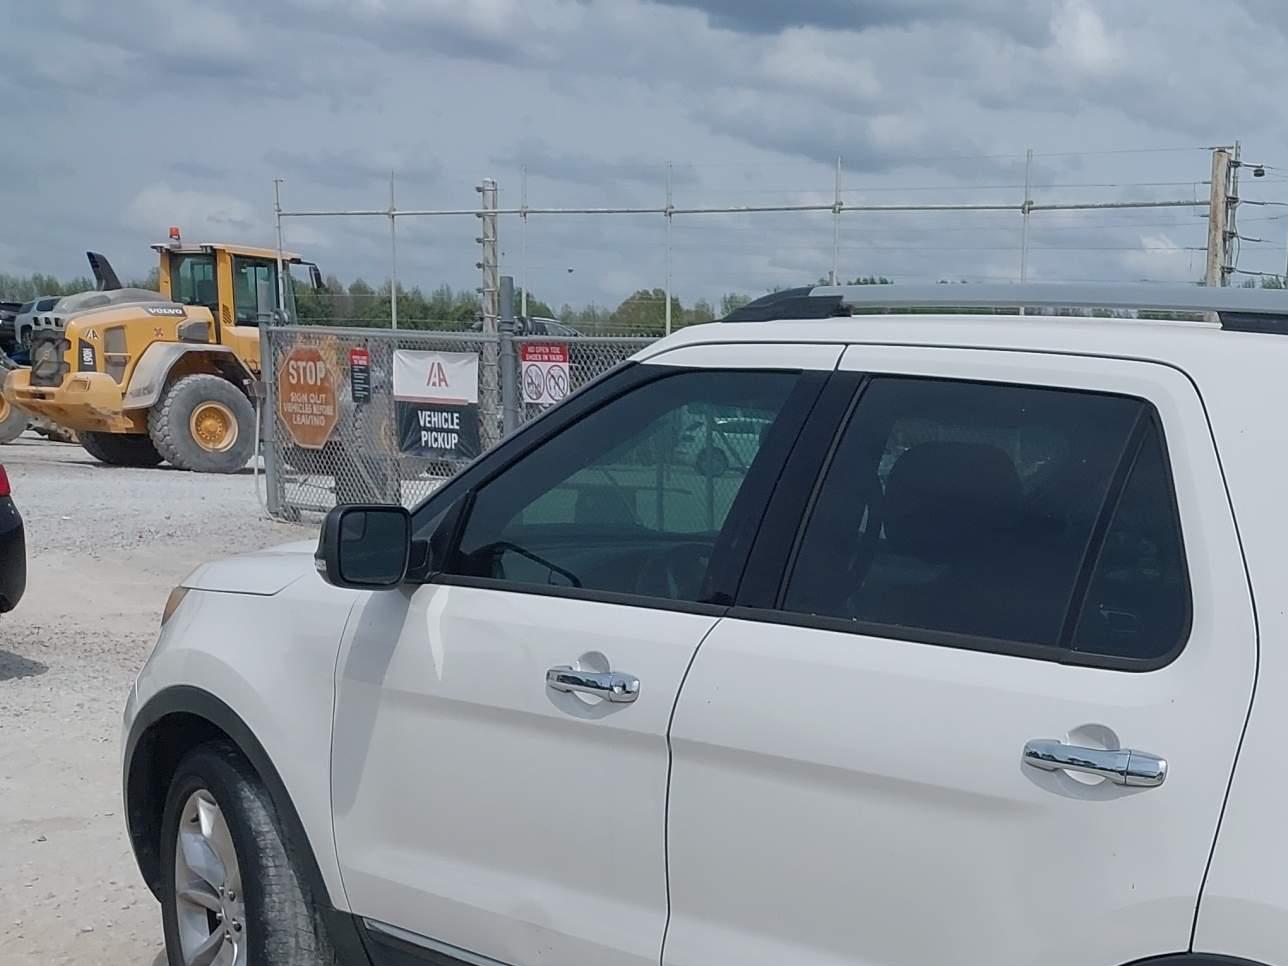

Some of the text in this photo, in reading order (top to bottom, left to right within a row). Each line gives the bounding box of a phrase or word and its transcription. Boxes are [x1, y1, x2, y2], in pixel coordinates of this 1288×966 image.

[148, 307, 183, 315] VOLVO
[288, 360, 326, 385] STOP
[290, 391, 326, 404] SIGN OUT
[283, 402, 312, 414] VEHICLES
[292, 414, 326, 426] LEAVING
[417, 410, 460, 429] VEHICLE
[421, 430, 458, 449] PICKUP
